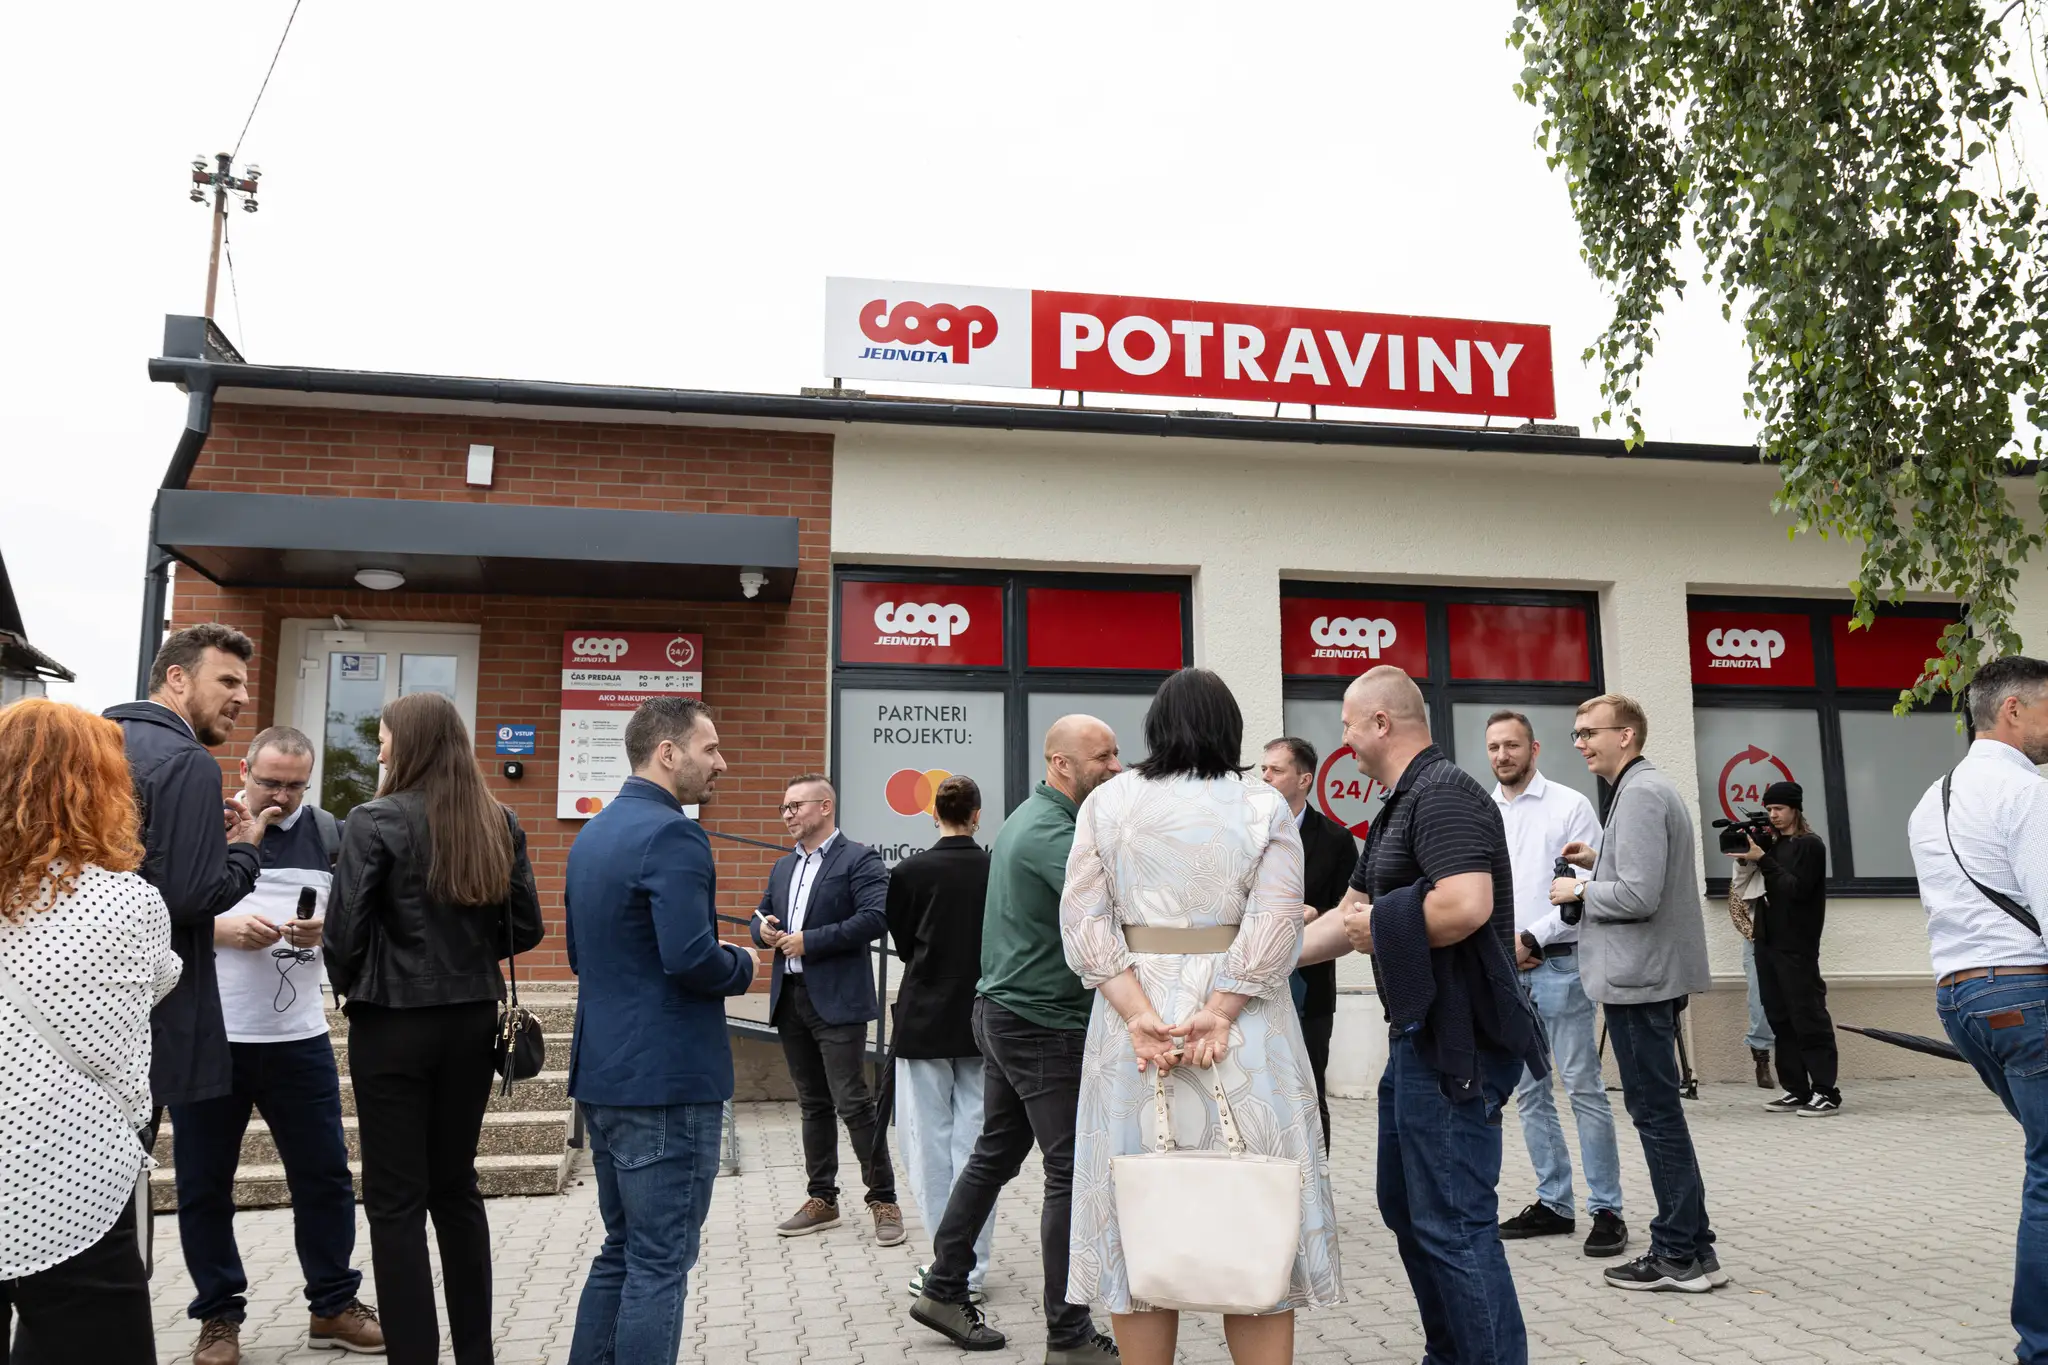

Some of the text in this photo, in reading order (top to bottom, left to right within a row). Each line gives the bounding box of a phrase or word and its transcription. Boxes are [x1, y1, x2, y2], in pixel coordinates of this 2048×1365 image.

[858, 347, 948, 364] JEDNOTA
[1060, 312, 1525, 397] POTRAVINY
[874, 636, 936, 646] JEDNOTA
[670, 648, 691, 656] 24/7
[1311, 649, 1367, 659] JEDNOTA
[1709, 659, 1759, 668] JEDNOTA
[571, 672, 586, 681] ČAS
[878, 705, 967, 722] PARTNERI
[873, 728, 972, 744] PROJEKTU:
